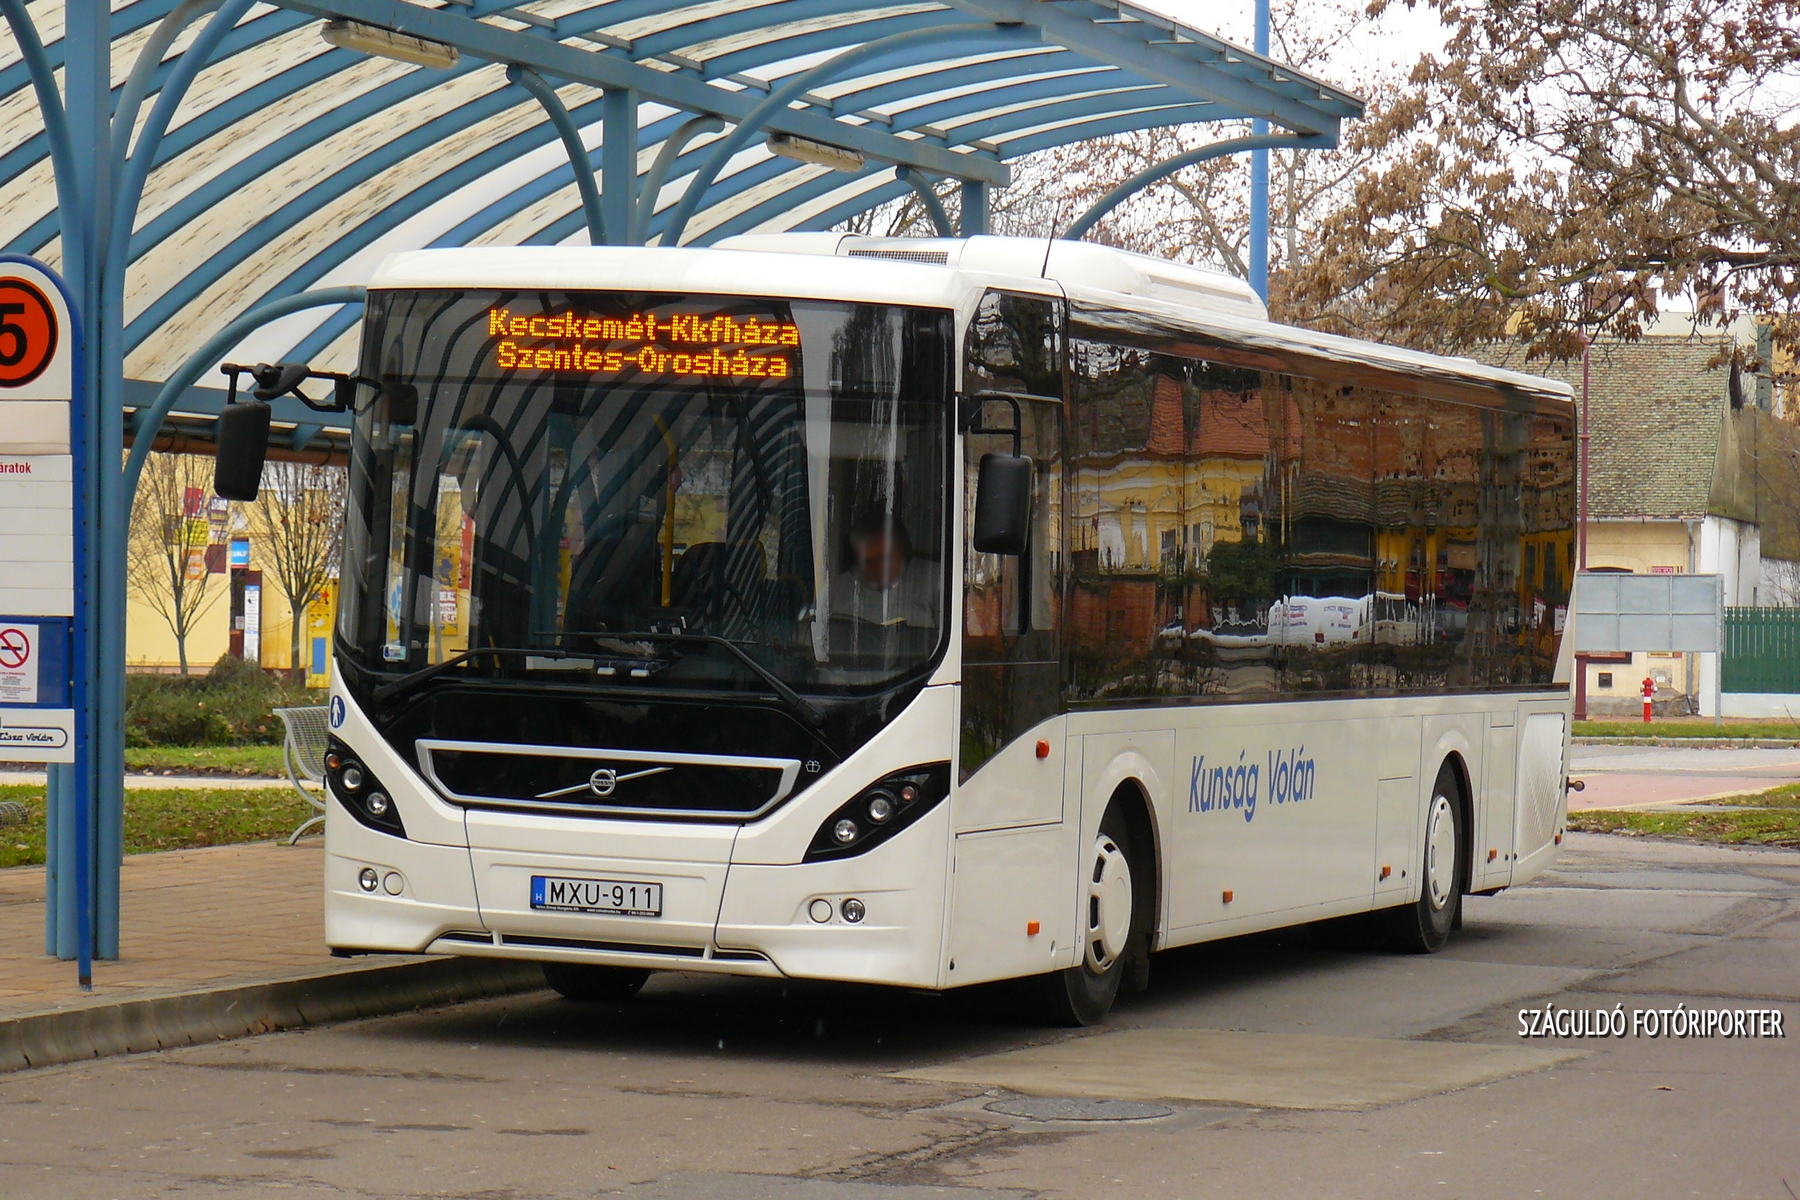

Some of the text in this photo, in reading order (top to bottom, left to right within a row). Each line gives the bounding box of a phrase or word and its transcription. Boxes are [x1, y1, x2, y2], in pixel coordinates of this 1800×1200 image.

[0, 303, 27, 366] 5
[489, 309, 799, 345] Kecskemét-Kkfháza
[498, 340, 788, 377] Szentes-Orosháza
[1188, 744, 1315, 823] Kunság Volán
[536, 882, 651, 908] H MXU-911
